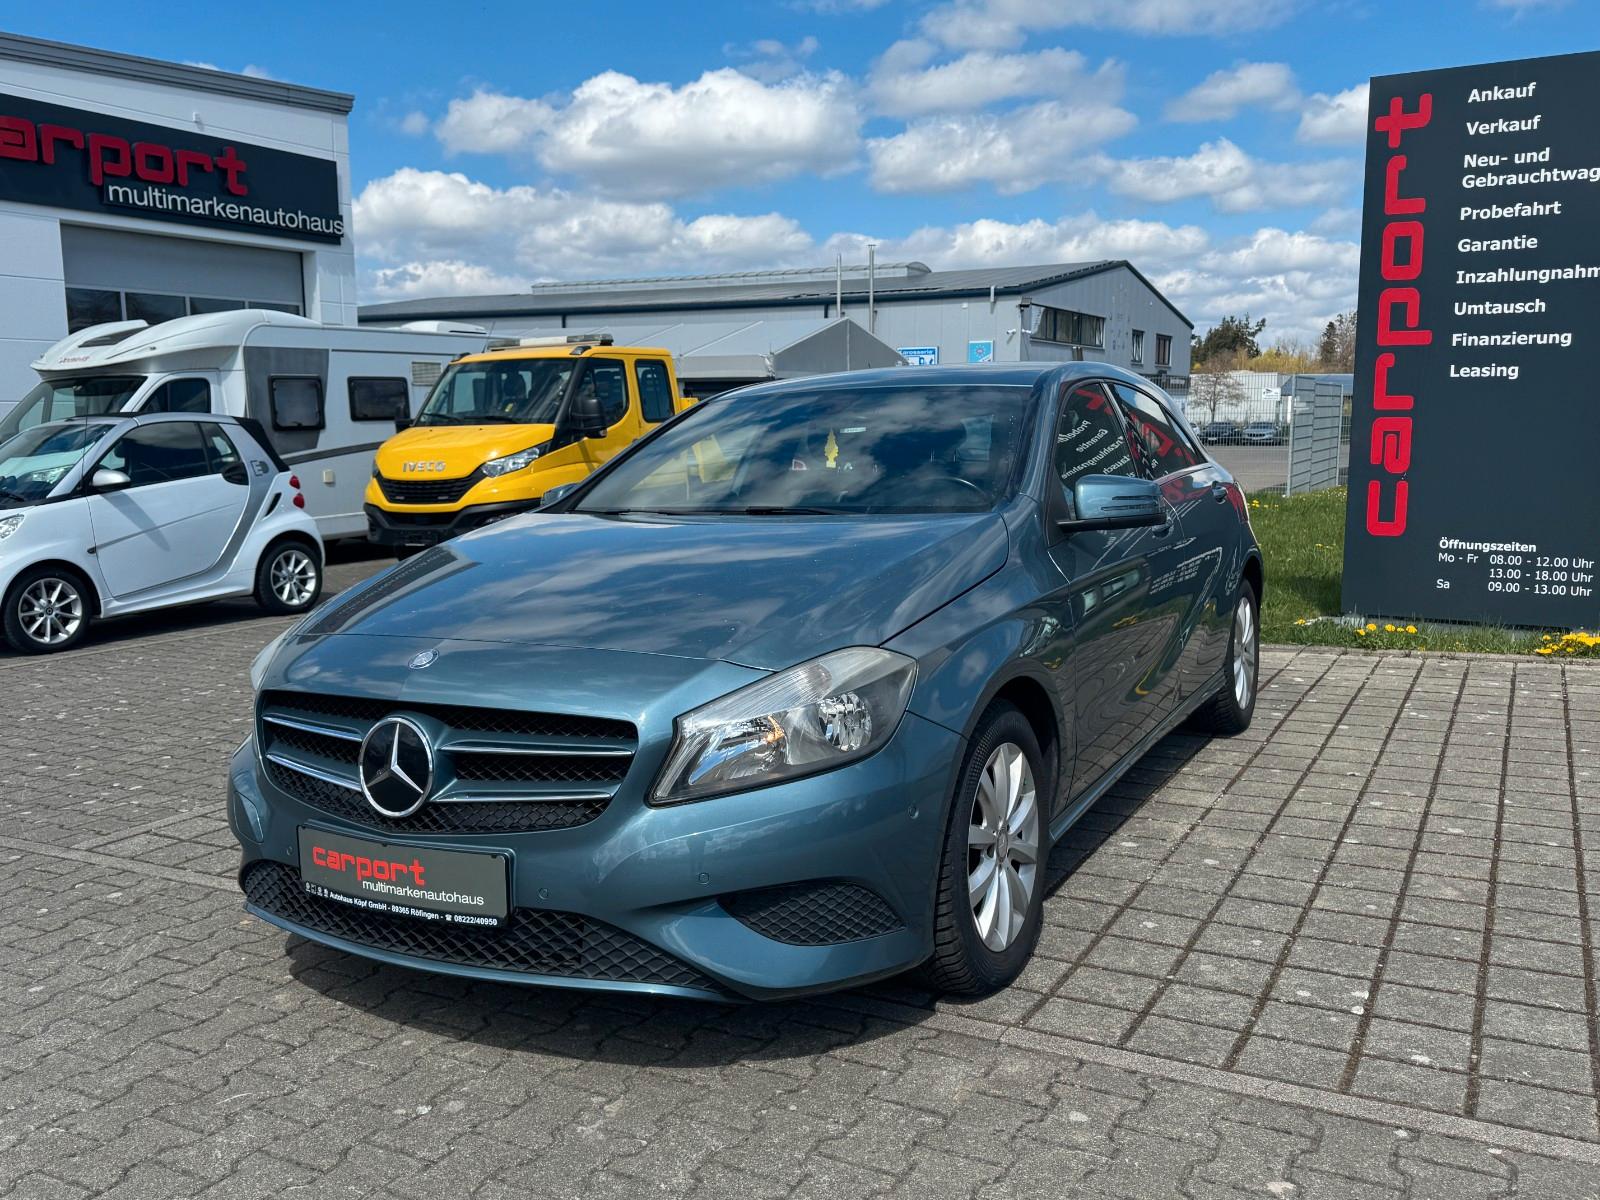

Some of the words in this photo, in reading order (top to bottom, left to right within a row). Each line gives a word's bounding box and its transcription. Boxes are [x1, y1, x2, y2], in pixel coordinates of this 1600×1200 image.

[1467, 81, 1537, 104] Ankauf
[1466, 114, 1542, 136] Verkauf
[1463, 153, 1509, 169] Neu-
[1514, 147, 1551, 165] und
[1461, 166, 1600, 189] Gebrauchtwag
[108, 183, 345, 236] multimarkenautohaus
[1460, 200, 1562, 221] Probefahrt
[1457, 234, 1538, 253] Garantie
[1366, 93, 1433, 537] carport
[1453, 298, 1546, 316] Umtausch
[1451, 331, 1572, 348] Finanzierung
[1449, 363, 1520, 380] Leasing
[402, 461, 447, 473] IVECO
[1438, 536, 1538, 553] Öffnungszeiten
[1438, 553, 1455, 563] Mo
[1466, 554, 1479, 564] Fr
[1489, 554, 1522, 566] 08.00
[1535, 556, 1569, 568] 12.00
[1572, 557, 1595, 569] Uhr
[1489, 568, 1521, 580] 13.00
[1534, 570, 1568, 582] 18.00
[1571, 571, 1594, 583] Uhr
[1436, 579, 1450, 589] Sa
[1487, 581, 1520, 593] 09.00
[1533, 584, 1567, 596] 13.00
[1570, 586, 1593, 597] Uhr
[312, 846, 426, 886] carport
[362, 879, 485, 906] multimarkenautohaus
[329, 891, 353, 904] Autohaus
[353, 897, 368, 909] Köpf
[368, 900, 387, 911] GmbH
[391, 904, 410, 915] 89365
[453, 914, 498, 926] 08222/40950
